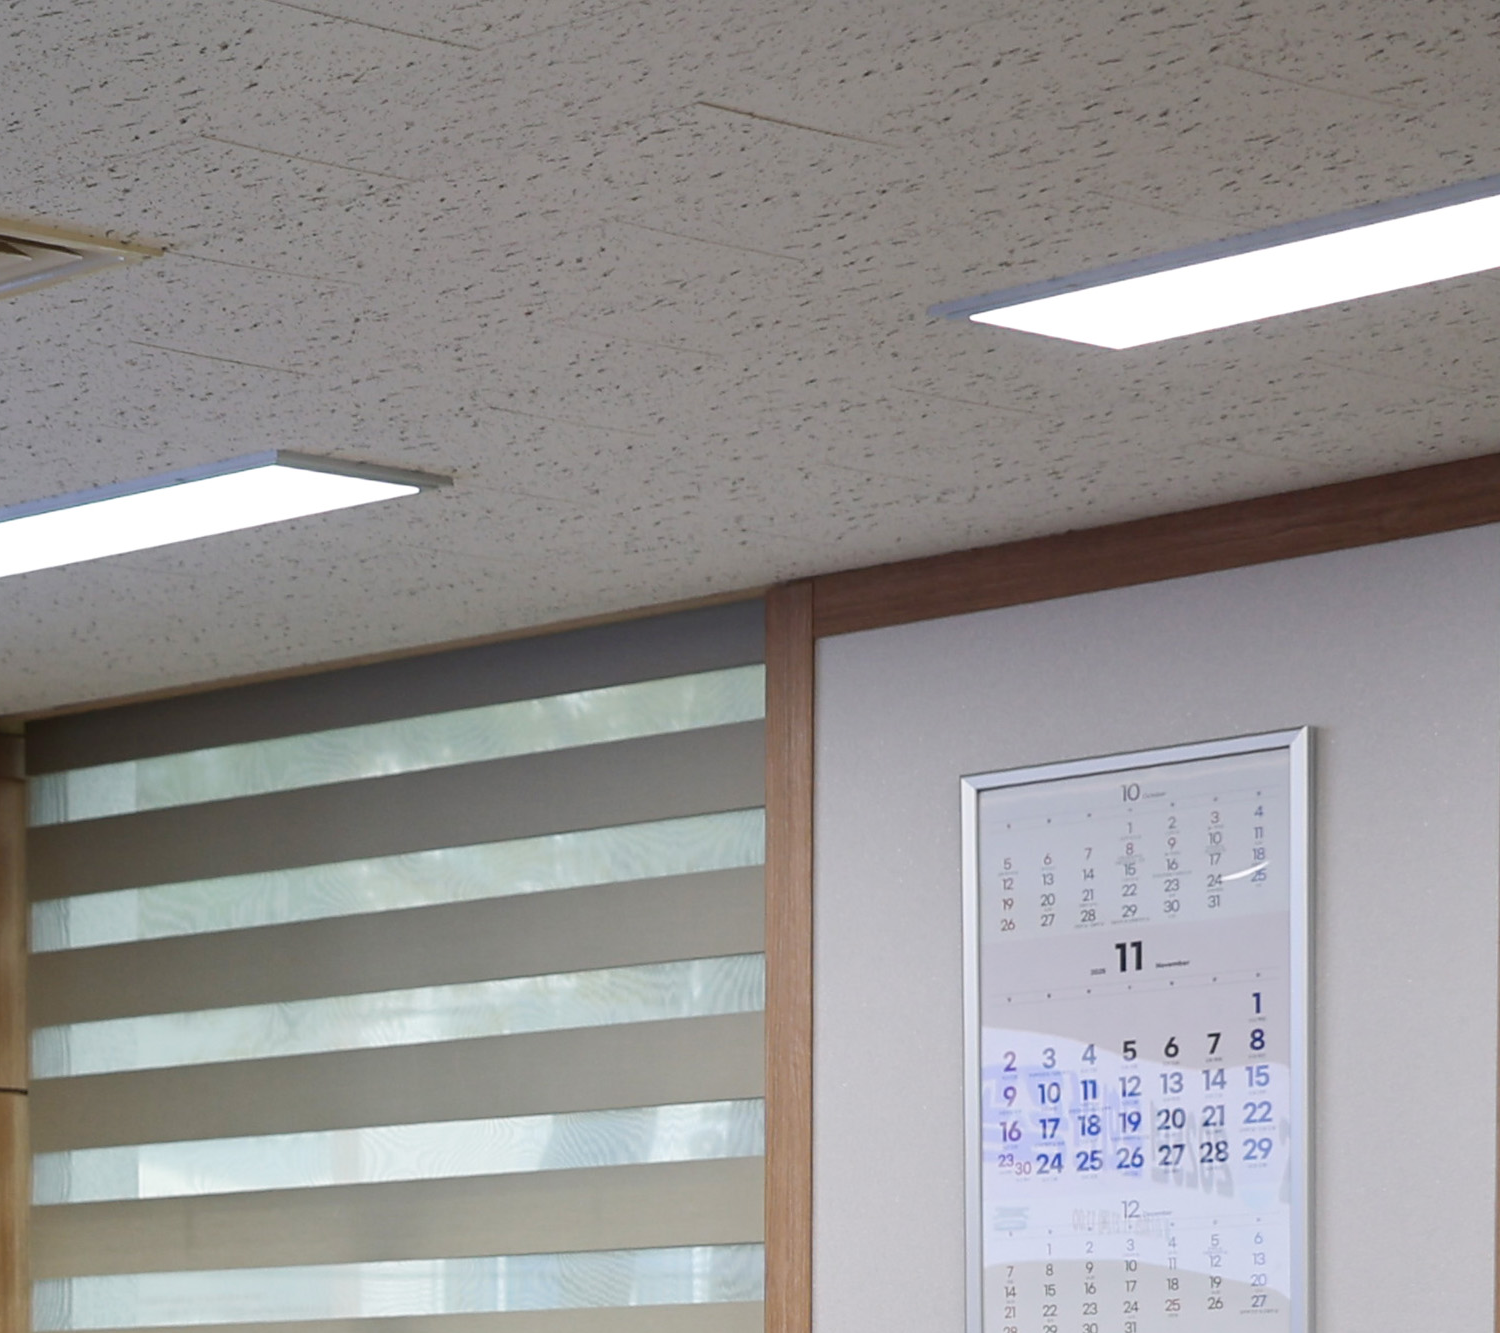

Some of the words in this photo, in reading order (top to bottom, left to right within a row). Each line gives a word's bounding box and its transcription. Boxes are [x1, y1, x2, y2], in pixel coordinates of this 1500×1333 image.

[1121, 783, 1140, 802] 10
[1128, 823, 1132, 834] 1
[1168, 817, 1176, 830] 2
[1210, 812, 1220, 824] 3
[1254, 806, 1263, 817] 4
[1004, 859, 1011, 870] 5
[1044, 854, 1052, 866] 6
[1085, 848, 1092, 860] 7
[1126, 843, 1134, 856] 8
[1168, 837, 1176, 850] 9
[1208, 832, 1222, 845] 10
[1254, 827, 1263, 839] 11
[1002, 878, 1014, 890] 12
[1042, 874, 1054, 886] 13
[1083, 868, 1094, 880] 14
[1124, 863, 1136, 876] 15
[1166, 859, 1178, 871] 16
[1210, 853, 1220, 866] 17
[1253, 848, 1265, 860] 18
[1002, 899, 1013, 910] 19
[1041, 894, 1055, 907] 20
[1082, 889, 1094, 902] 21
[1122, 884, 1136, 896] 22
[1164, 880, 1179, 892] 23
[1207, 875, 1222, 888] 24
[1252, 869, 1266, 882] 25
[1000, 919, 1015, 931] 26
[1041, 914, 1054, 927] 27
[1080, 910, 1096, 922] 28
[1122, 905, 1137, 918] 29
[1164, 900, 1180, 914] 30
[1208, 896, 1220, 908] 31
[1114, 941, 1142, 972] 11
[1252, 992, 1261, 1014] 1
[1004, 1052, 1016, 1072] 2
[1042, 1048, 1056, 1069] 3
[1082, 1044, 1096, 1064] 4
[1123, 1040, 1136, 1061] 5
[1164, 1036, 1179, 1058] 6
[1207, 1033, 1221, 1054] 7
[1250, 1029, 1264, 1050] 8
[1004, 1086, 1016, 1106] 9
[1038, 1082, 1060, 1104] 10
[1080, 1080, 1097, 1100] 11
[1119, 1076, 1141, 1097] 12
[1160, 1072, 1184, 1094] 13
[1202, 1068, 1226, 1090] 14
[1246, 1065, 1270, 1087] 15
[1000, 1120, 1021, 1142] 16
[1039, 1118, 1060, 1139] 17
[1078, 1114, 1100, 1136] 18
[1119, 1111, 1141, 1132] 19
[1157, 1108, 1186, 1130] 20
[1202, 1105, 1225, 1126] 21
[1243, 1102, 1272, 1124] 22
[998, 1154, 1014, 1168] 23
[1015, 1160, 1031, 1175] 30
[1036, 1153, 1063, 1174] 24
[1076, 1150, 1102, 1171] 25
[1116, 1147, 1144, 1169] 26
[1158, 1144, 1184, 1166] 27
[1200, 1140, 1228, 1163] 28
[1243, 1138, 1272, 1160] 29
[1122, 1200, 1140, 1219] 12
[1048, 1244, 1052, 1255] 1
[1086, 1242, 1094, 1254] 2
[1126, 1239, 1134, 1251] 3
[1168, 1237, 1176, 1248] 4
[1211, 1234, 1219, 1246] 5
[1254, 1232, 1263, 1244] 6
[1006, 1266, 1014, 1278] 7
[1046, 1264, 1054, 1276] 8
[1086, 1262, 1094, 1274] 9
[1125, 1260, 1137, 1272] 10
[1168, 1258, 1176, 1270] 11
[1210, 1256, 1221, 1268] 12
[1253, 1252, 1265, 1265] 13
[1004, 1286, 1016, 1298] 14
[1044, 1284, 1056, 1296] 15
[1084, 1282, 1096, 1294] 16
[1126, 1280, 1137, 1292] 17
[1167, 1278, 1179, 1290] 18
[1210, 1276, 1222, 1288] 19
[1251, 1274, 1266, 1286] 20
[1004, 1306, 1016, 1318] 21
[1042, 1304, 1057, 1316] 22
[1083, 1303, 1098, 1315] 23
[1123, 1301, 1138, 1313] 24
[1165, 1299, 1180, 1312] 25
[1208, 1297, 1223, 1310] 26
[1252, 1295, 1267, 1308] 27
[1124, 1322, 1136, 1333] 31
